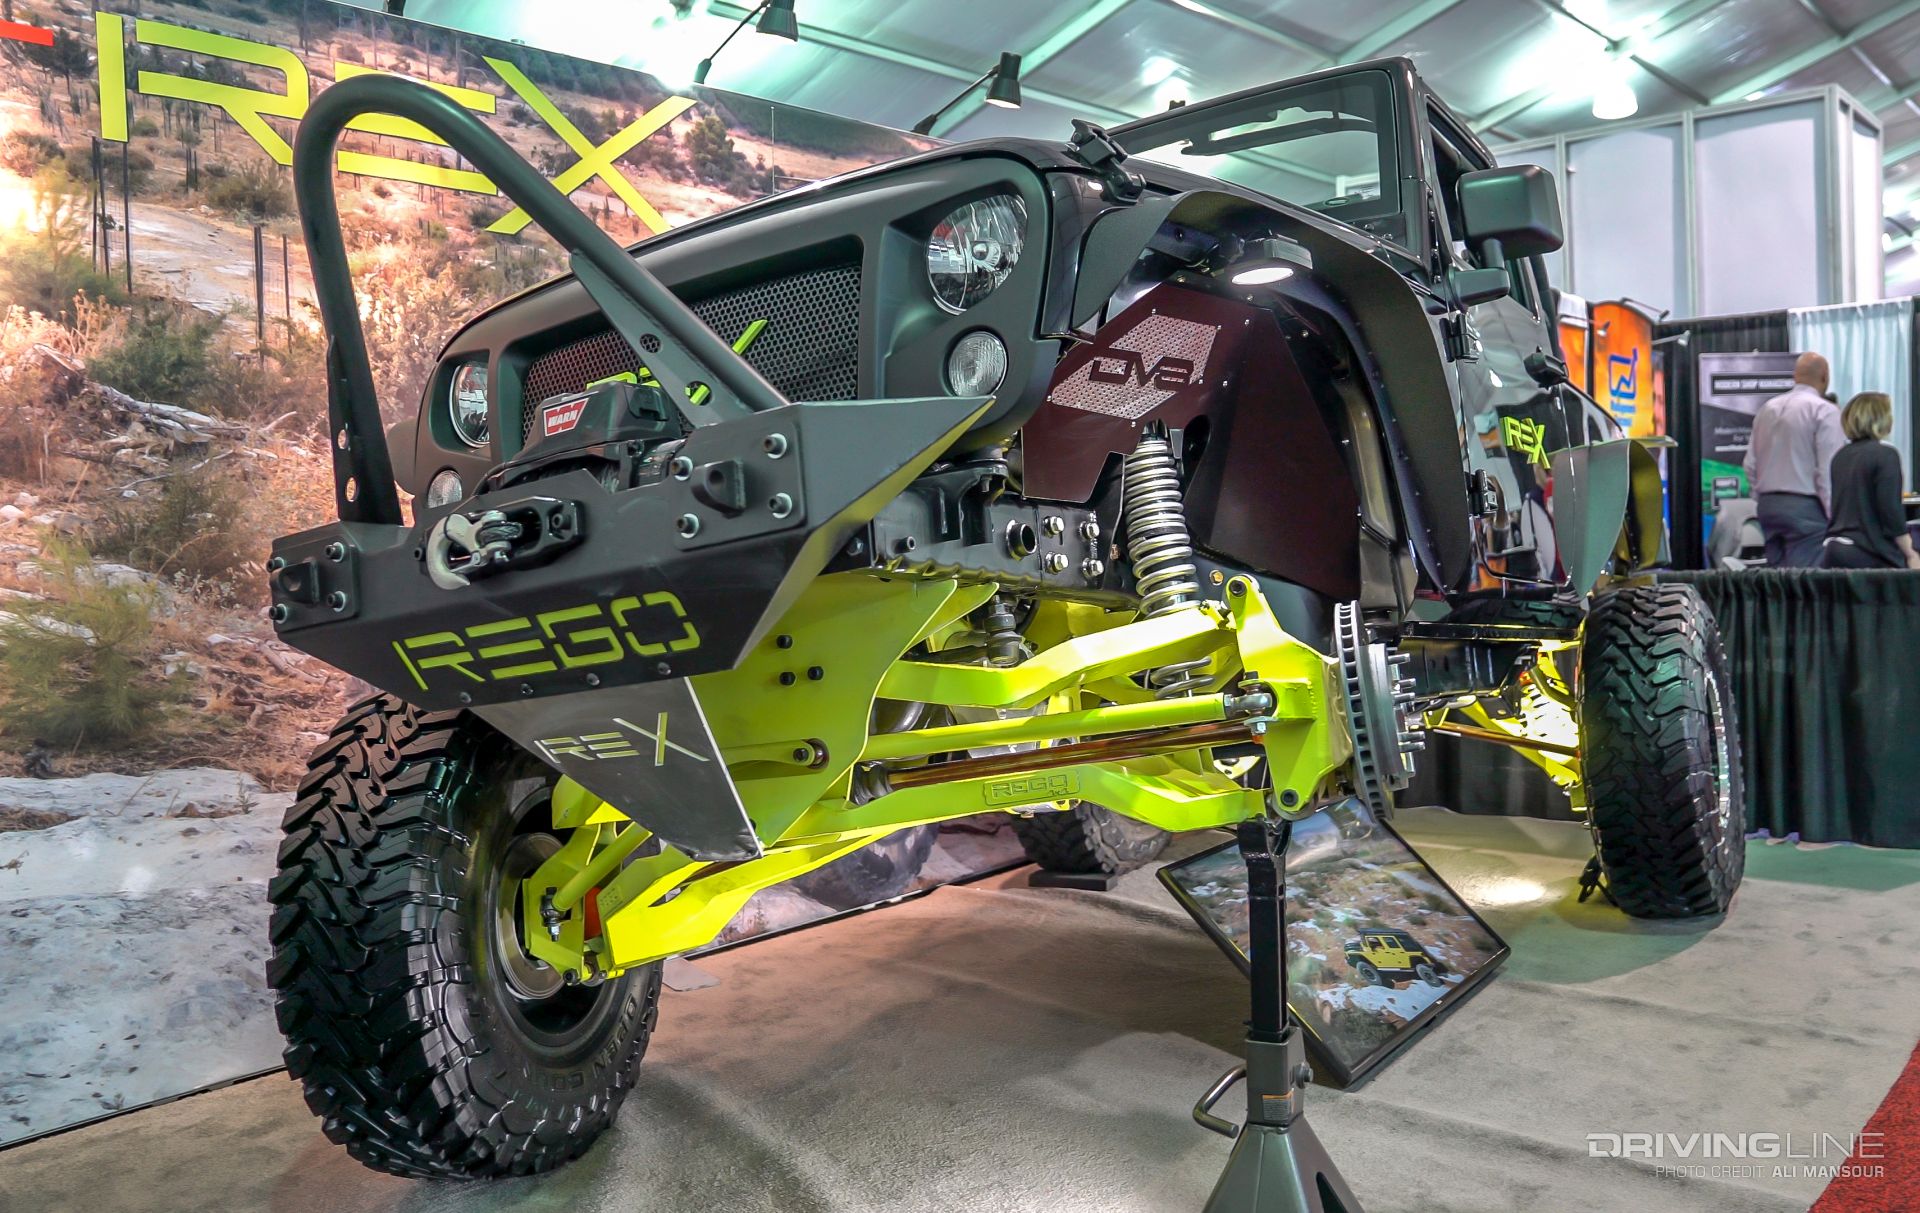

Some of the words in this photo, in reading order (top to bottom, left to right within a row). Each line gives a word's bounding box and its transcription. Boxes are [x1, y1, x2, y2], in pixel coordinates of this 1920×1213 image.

[96, 11, 696, 235] REX
[548, 411, 578, 427] WARN
[1499, 416, 1551, 469] REX
[392, 590, 701, 691] REGO
[533, 711, 710, 767] REX
[991, 774, 1068, 798] REGO
